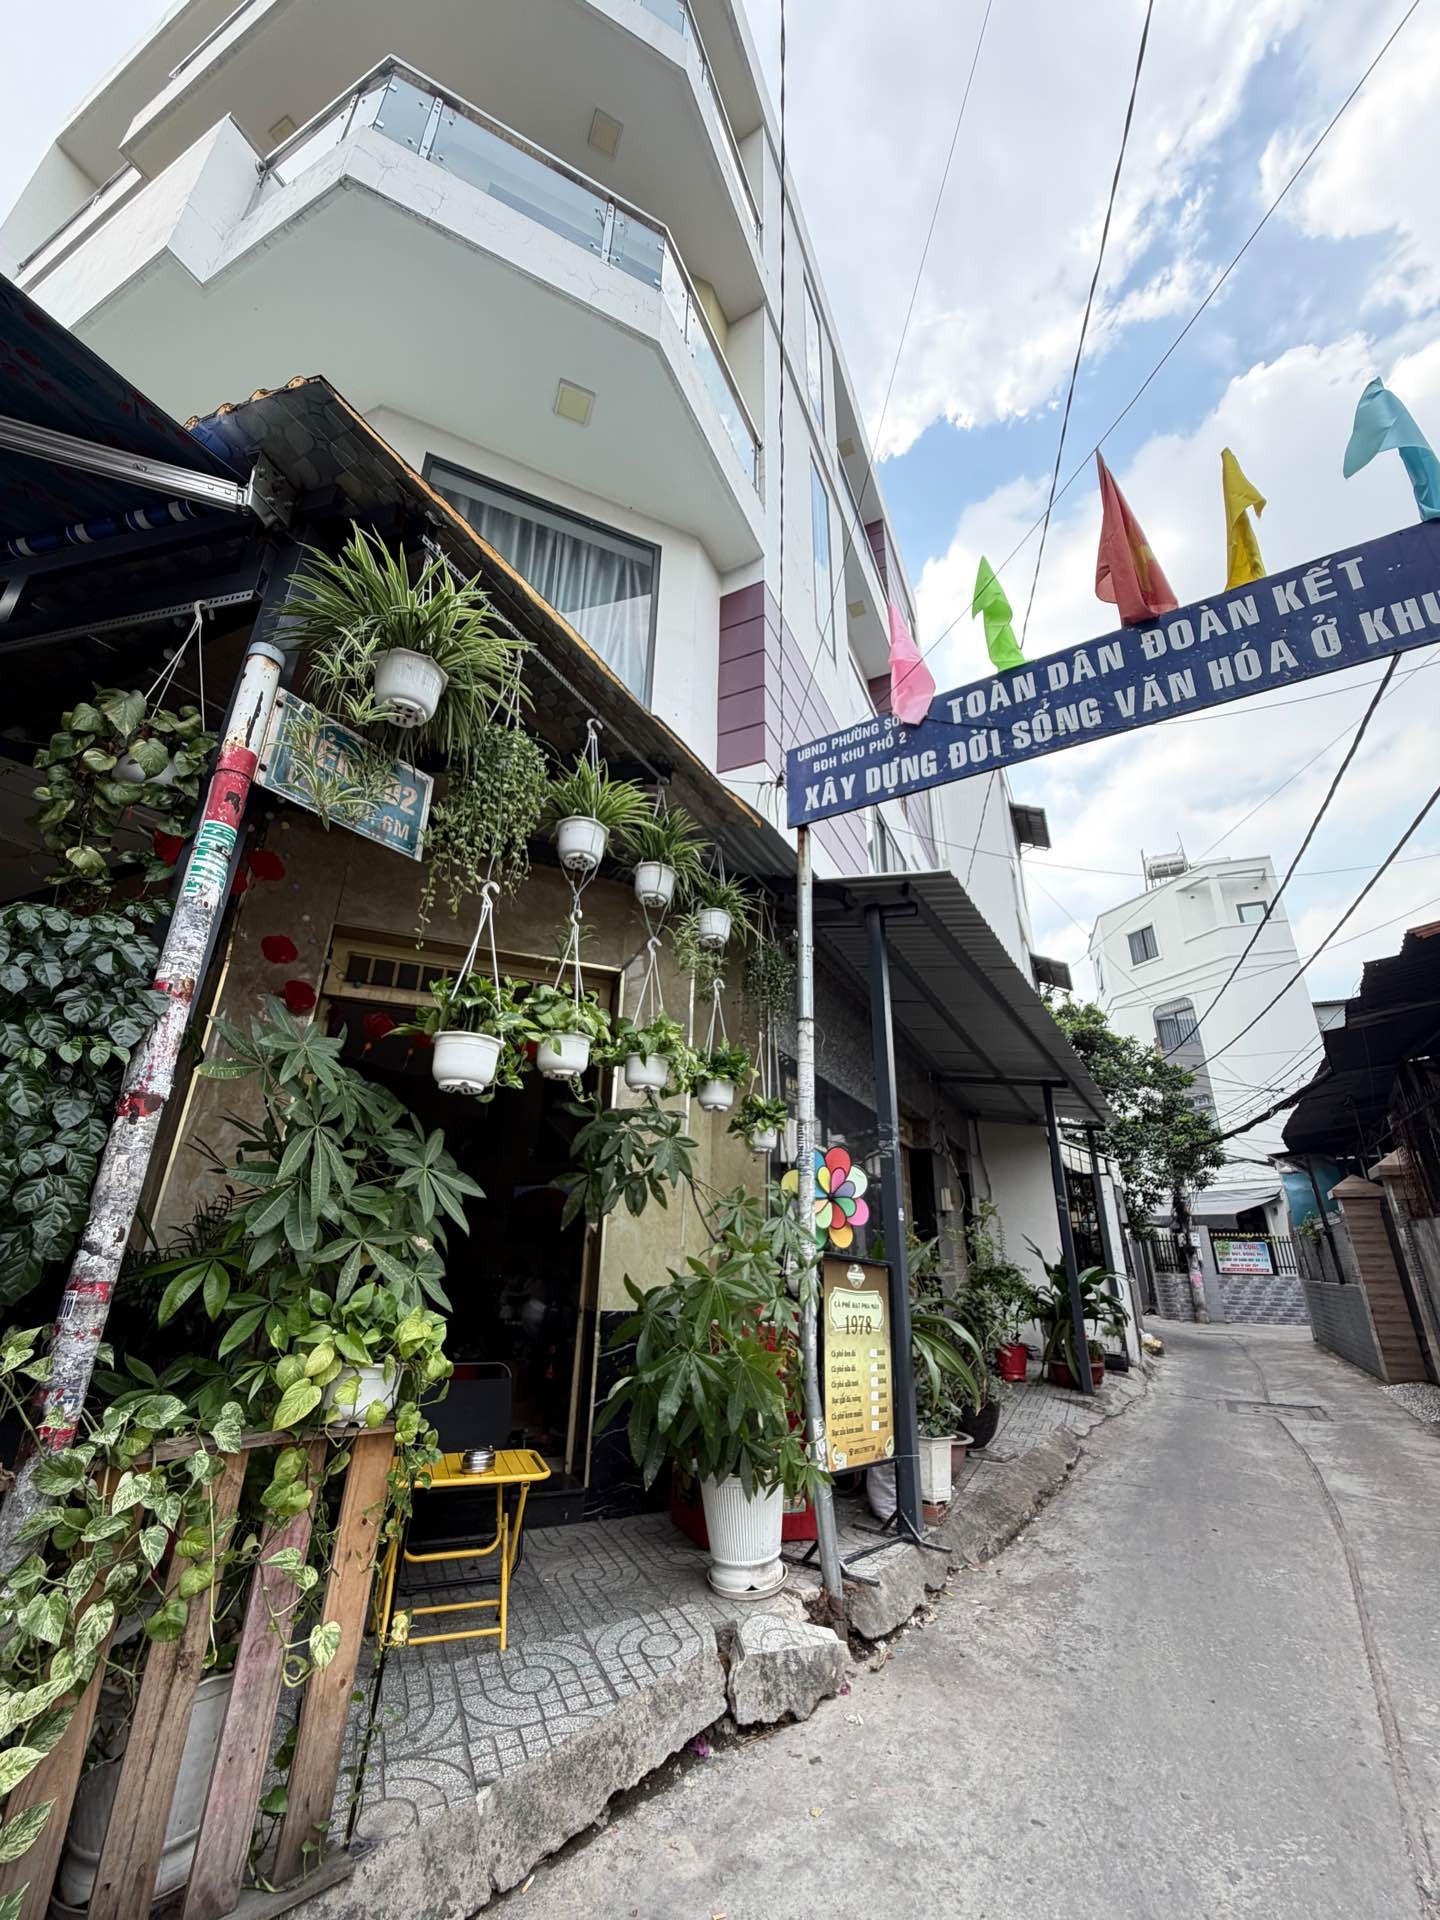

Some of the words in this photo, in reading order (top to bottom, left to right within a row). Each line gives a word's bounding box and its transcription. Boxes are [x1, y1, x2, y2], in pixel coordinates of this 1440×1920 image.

[946, 672, 1037, 724] TOÀN
[1047, 641, 1125, 691] DÂN
[1140, 595, 1260, 661] ĐOÀN
[1271, 556, 1365, 616] KẾT
[804, 774, 856, 812] XÂY
[865, 750, 938, 794] DỰNG
[948, 728, 1001, 770] ĐỜI
[1011, 697, 1102, 750] SỐNG
[1114, 668, 1197, 718] VĂN
[1207, 639, 1299, 691] HÓA
[1310, 613, 1342, 658] Ở
[797, 742, 827, 762] UBND
[831, 723, 879, 750] PHƯỜNG
[813, 755, 837, 774] BĐH
[841, 746, 865, 765] KHU
[869, 730, 894, 755] PHỐ
[898, 732, 907, 744] 2
[845, 1314, 873, 1336] 1978
